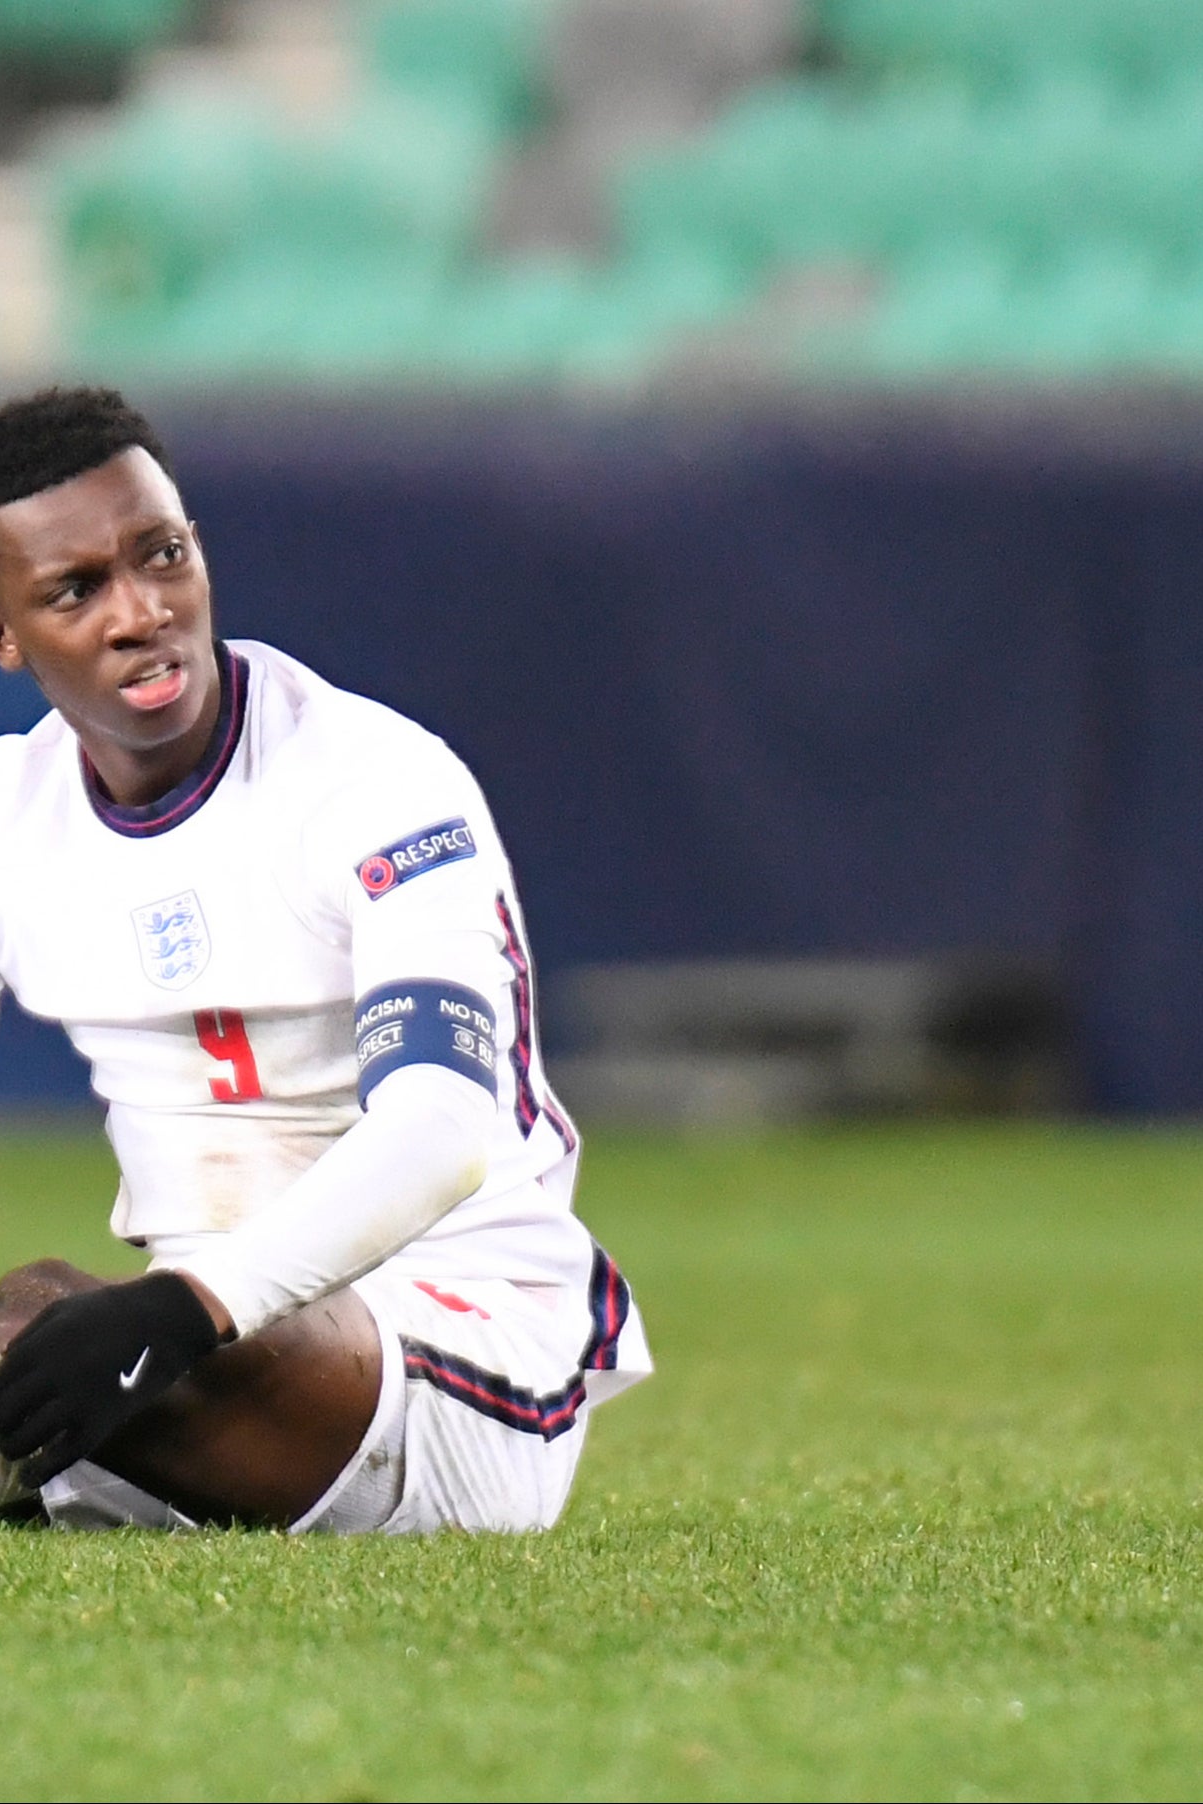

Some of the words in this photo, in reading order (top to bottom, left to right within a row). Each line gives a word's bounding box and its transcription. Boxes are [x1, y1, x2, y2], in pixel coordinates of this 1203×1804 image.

[391, 826, 473, 871] RESPECT
[440, 999, 470, 1020] NO
[471, 1010, 491, 1034] TO
[193, 1006, 264, 1104] 9
